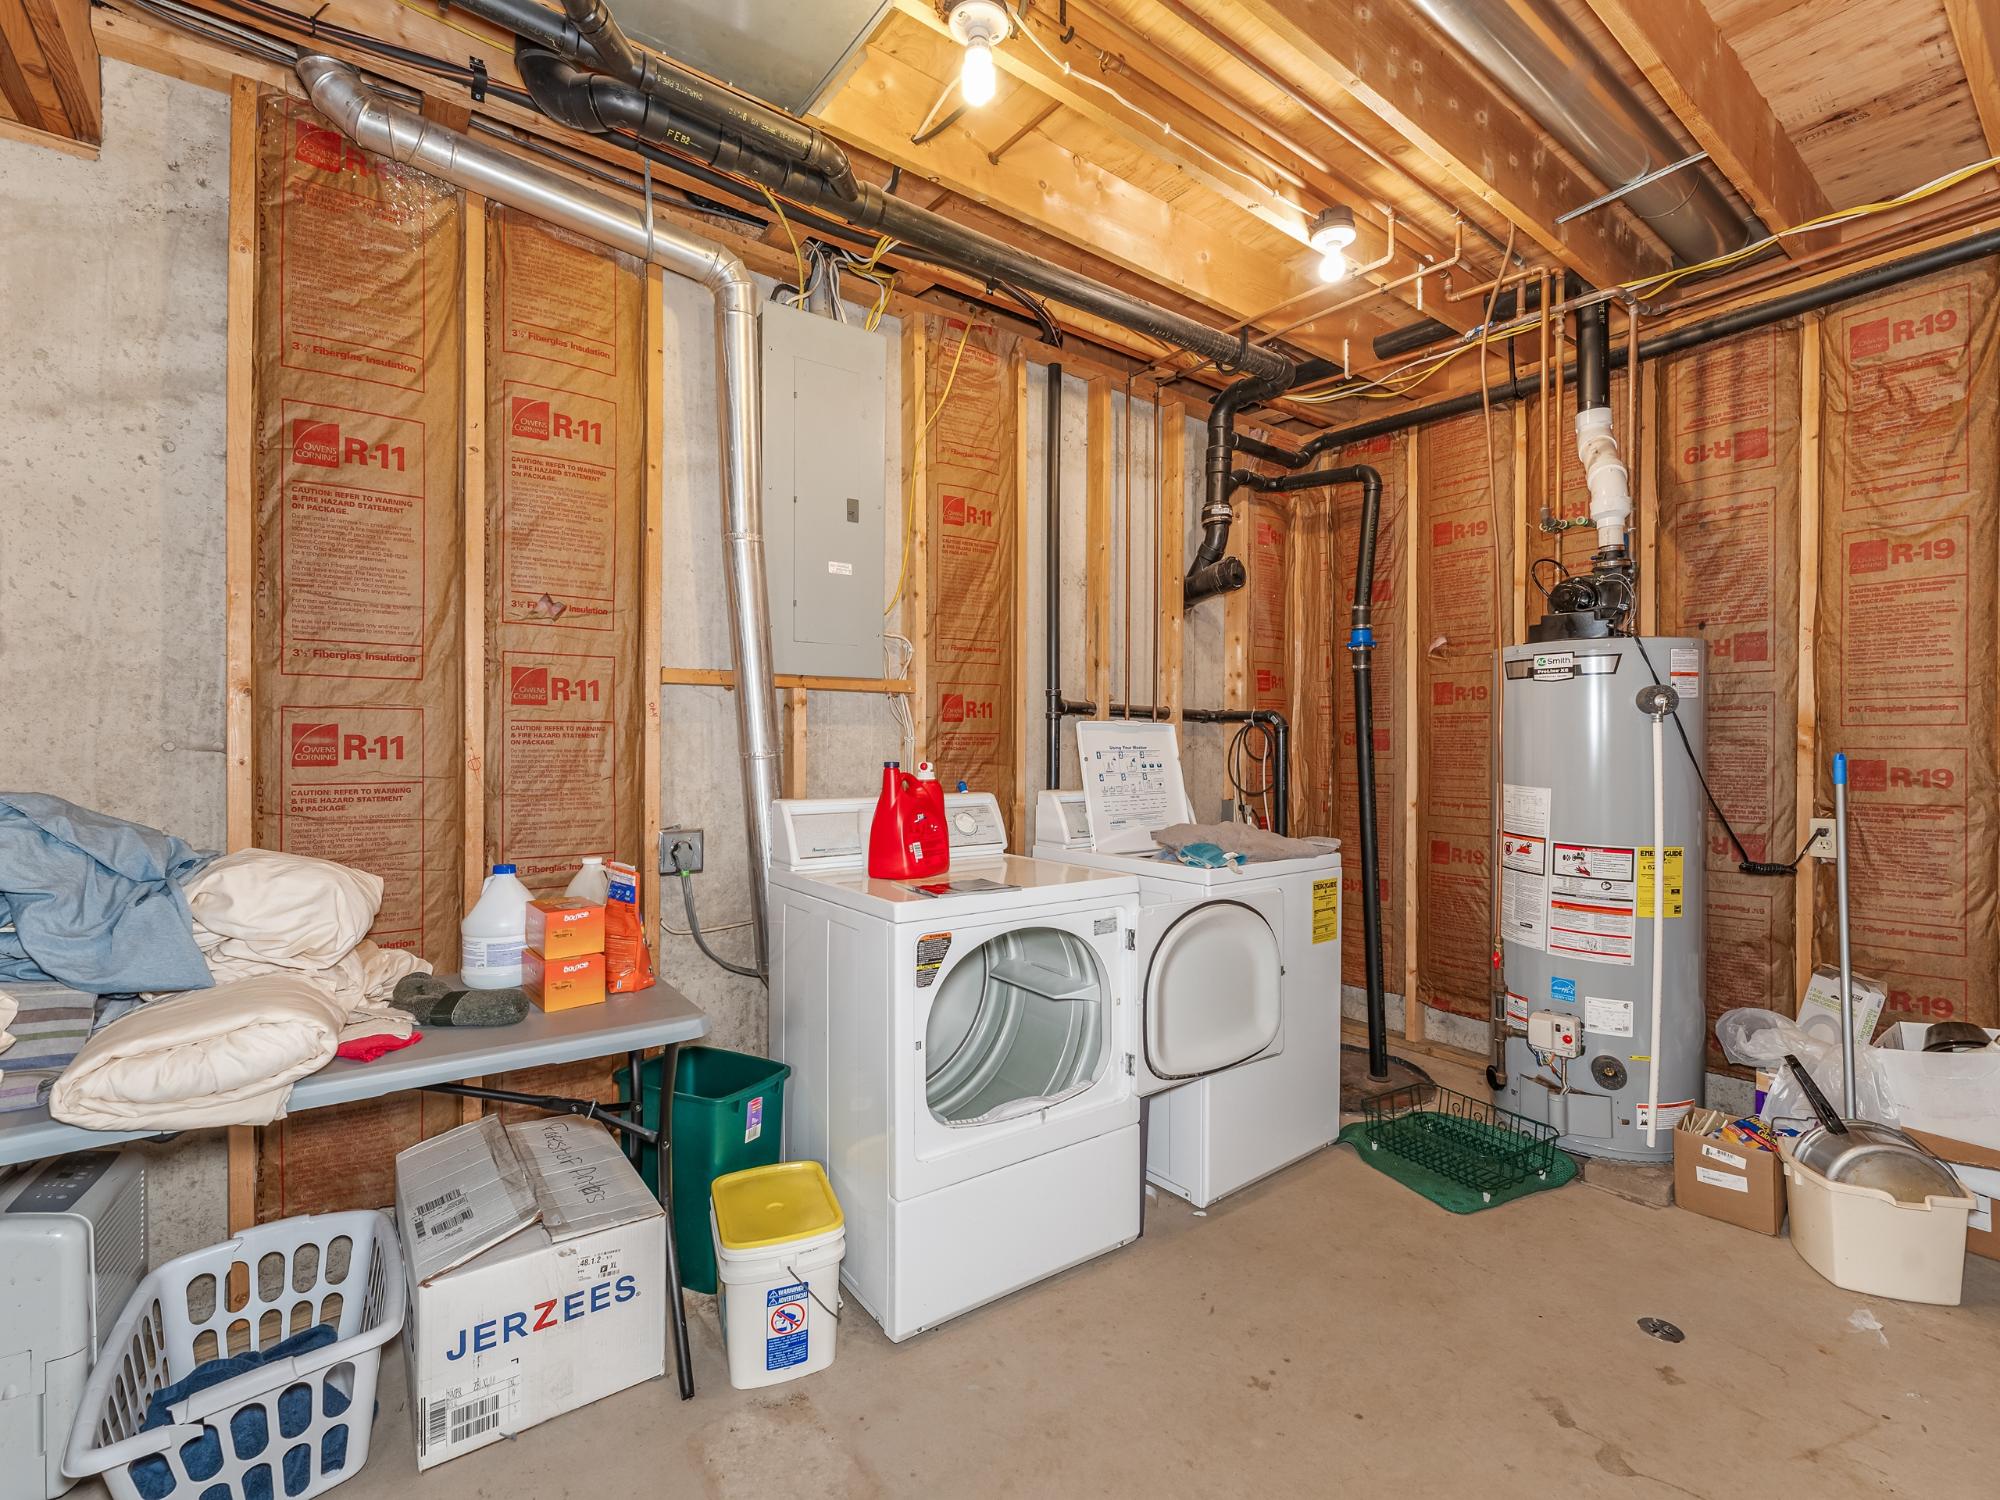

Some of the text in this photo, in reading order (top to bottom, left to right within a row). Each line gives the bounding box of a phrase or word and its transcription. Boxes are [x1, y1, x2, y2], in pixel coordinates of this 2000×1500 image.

[1893, 309, 1957, 344] R-19
[528, 332, 609, 359] Fiberglas Insulation
[366, 355, 416, 373] Insulation
[514, 424, 548, 435] CORNING
[554, 413, 601, 445] R-11
[296, 449, 336, 462] CORNING
[303, 442, 337, 454] OWENS
[345, 437, 405, 471] R-11
[1684, 439, 1731, 464] R-19
[535, 466, 562, 476] HAZARD
[564, 472, 600, 482] STATEMENT
[578, 466, 606, 477] WARNING
[292, 486, 332, 496] CAUTION:
[375, 496, 413, 507] WARNING
[307, 505, 349, 515] PACKAGE.
[321, 498, 355, 507] HAZARD
[358, 503, 404, 514] STATEMENT
[966, 506, 992, 527] R-11
[1454, 520, 1488, 540] R-19
[1891, 538, 1956, 564] R-19
[569, 605, 608, 615] Insulation
[1708, 639, 1731, 656] R-
[313, 650, 415, 663] Fiberglas Insulation
[552, 678, 599, 701] R-11
[1455, 686, 1488, 701] R-19
[966, 701, 992, 719] R-11
[344, 735, 403, 760] R-11
[1890, 767, 1954, 789] R-19
[1451, 848, 1484, 865] R-19
[528, 865, 566, 875] Fiberglas
[563, 910, 589, 922] bounce
[1909, 929, 1958, 942] Insulation
[378, 940, 415, 949] ulation
[563, 961, 589, 973] bounce
[1889, 990, 1954, 1019] R-19
[446, 1274, 637, 1362] JERZEES
